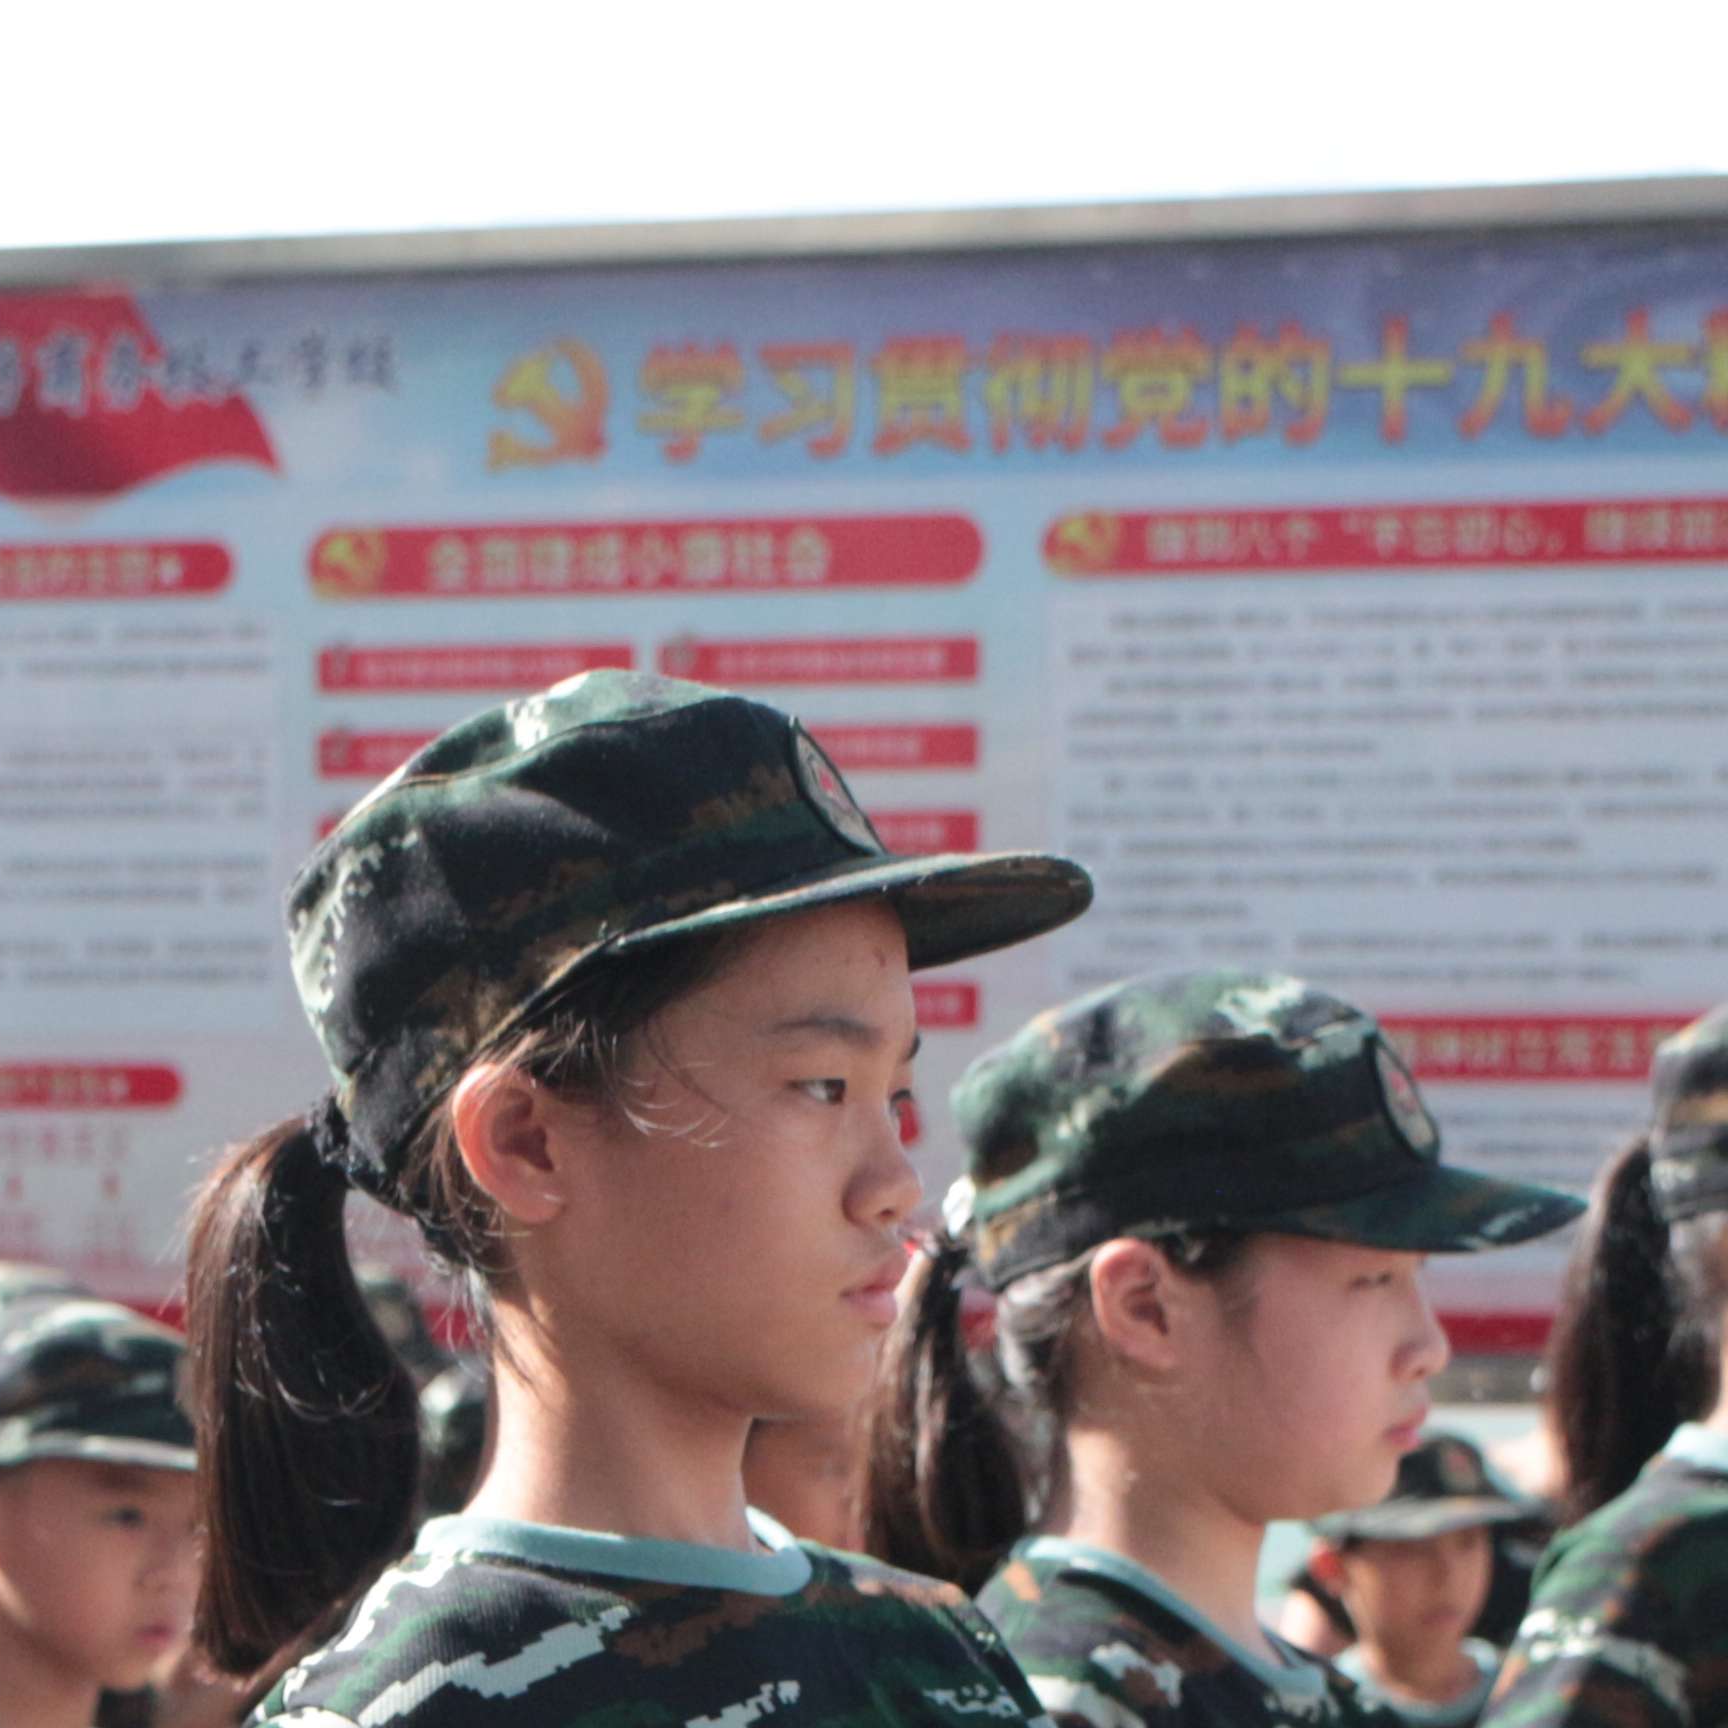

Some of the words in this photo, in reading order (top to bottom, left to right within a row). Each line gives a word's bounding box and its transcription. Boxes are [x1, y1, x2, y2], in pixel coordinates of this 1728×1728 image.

[426, 527, 831, 591] 全面建成小康社会
